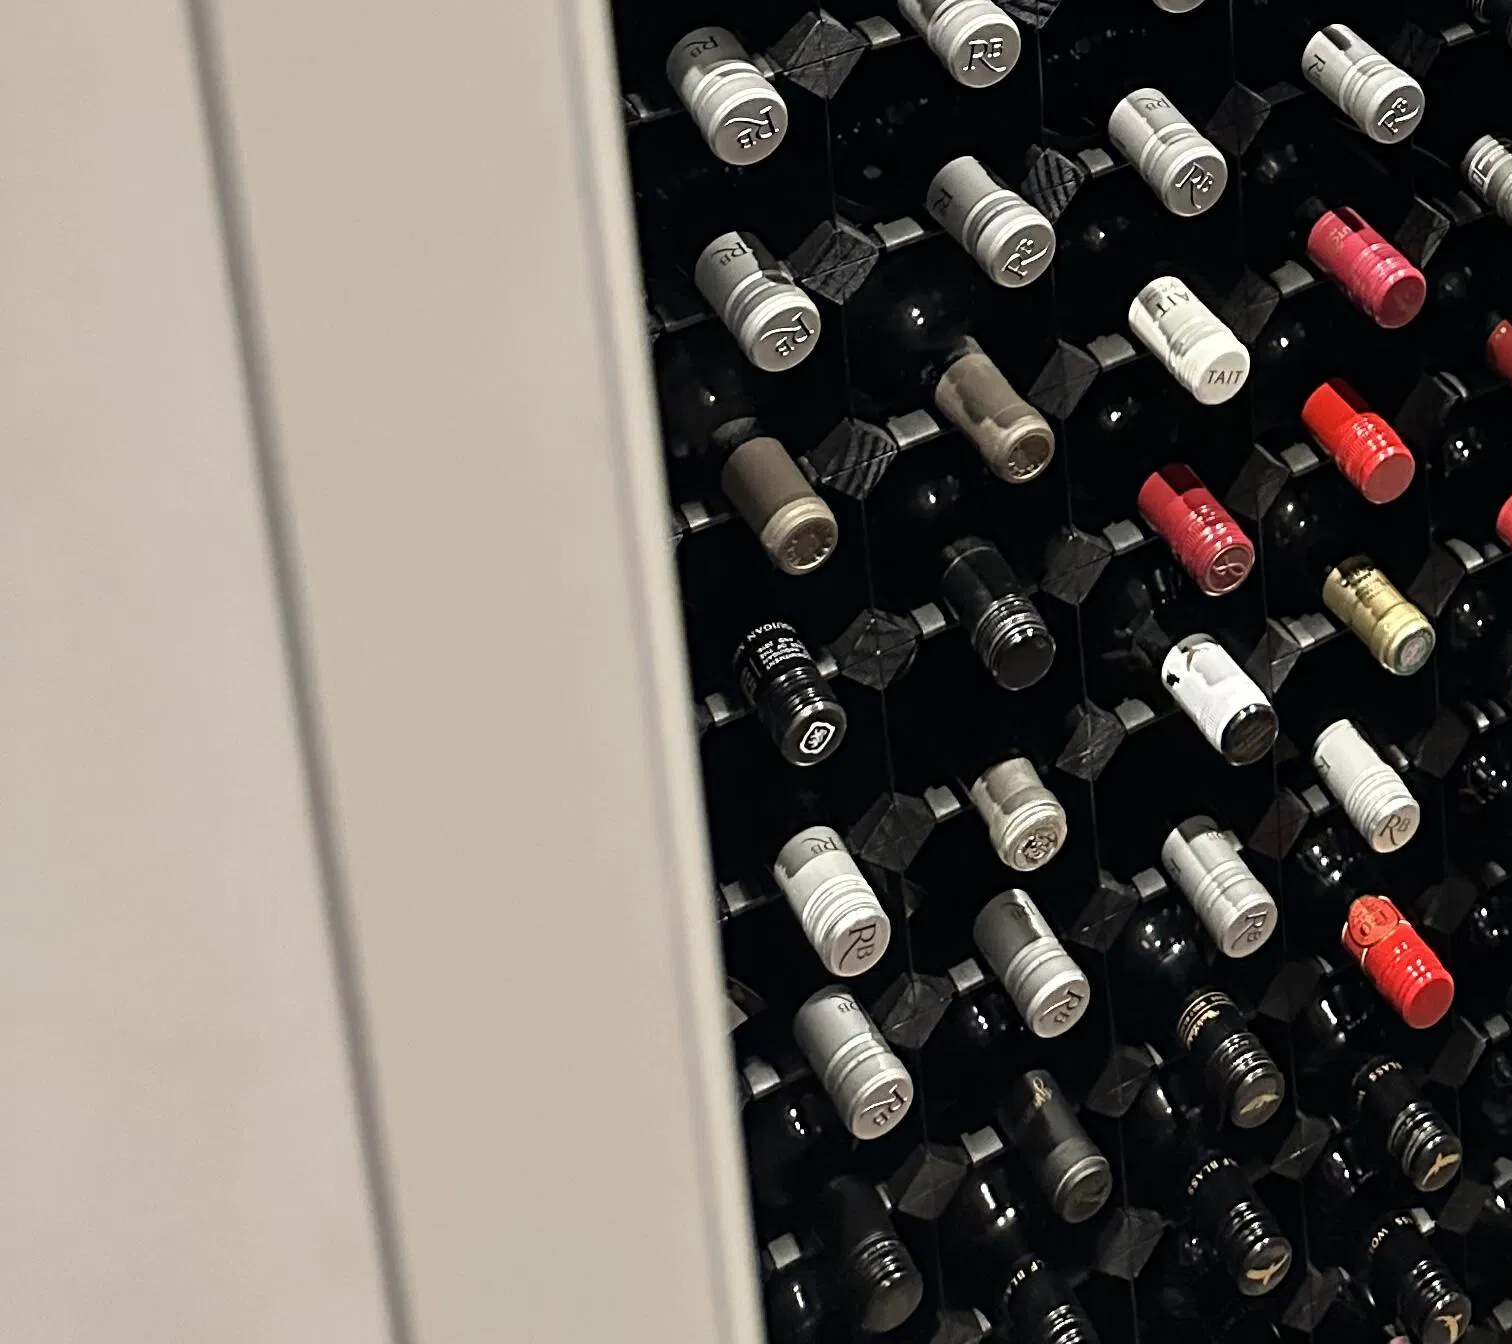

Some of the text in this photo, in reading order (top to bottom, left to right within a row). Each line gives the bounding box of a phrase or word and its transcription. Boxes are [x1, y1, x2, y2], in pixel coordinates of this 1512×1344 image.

[961, 37, 1007, 73] RB
[725, 104, 780, 149] RB
[1378, 96, 1420, 138] RB
[1174, 164, 1215, 210] RB
[1001, 237, 1049, 279] RB
[760, 312, 815, 357] RB
[1207, 370, 1244, 385] TAIT
[1379, 814, 1412, 847] RB
[838, 923, 877, 970] RB
[1232, 910, 1268, 951] RB
[1042, 989, 1083, 1024] RB
[860, 1083, 908, 1127] RB
